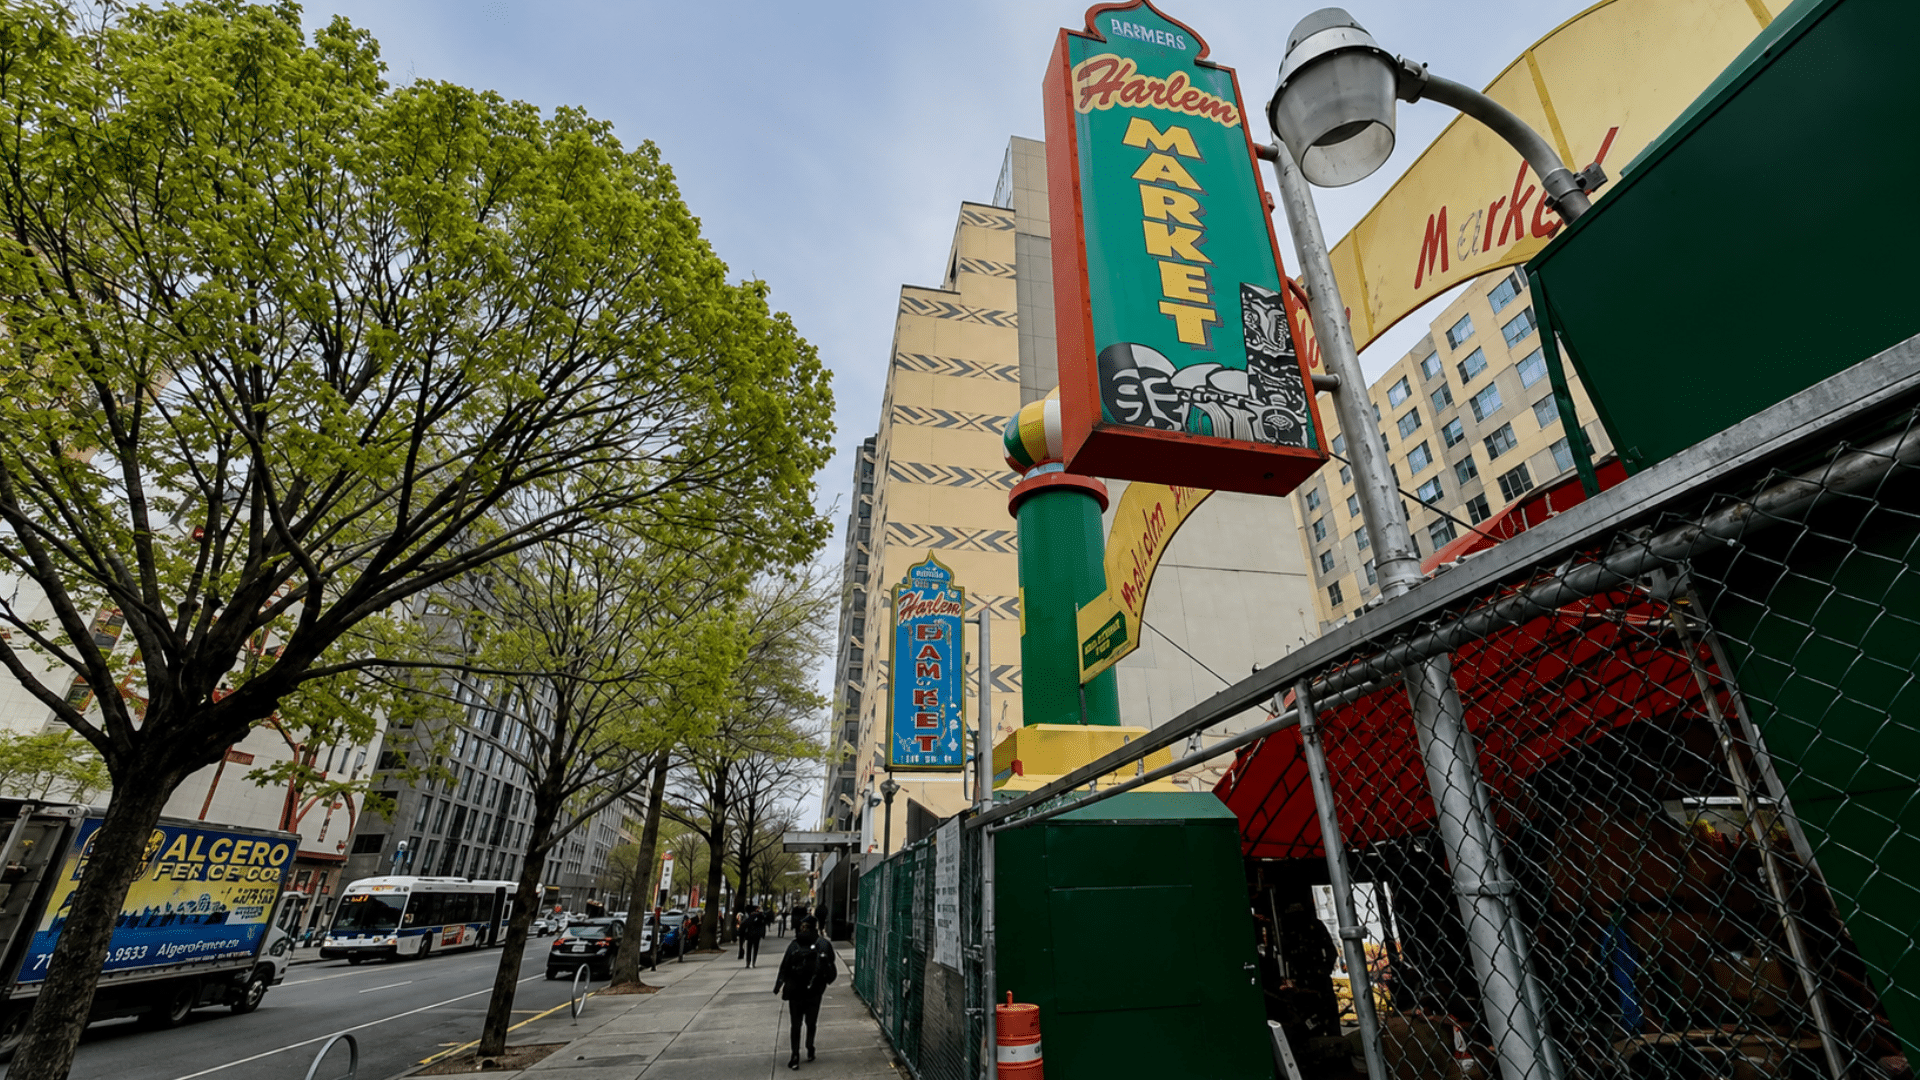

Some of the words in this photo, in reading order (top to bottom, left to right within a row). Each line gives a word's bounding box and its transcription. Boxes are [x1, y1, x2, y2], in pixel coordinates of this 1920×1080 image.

[1072, 54, 1241, 127] Harlem
[1122, 116, 1219, 348] MARKET
[897, 590, 961, 626] Harlem
[162, 833, 289, 866] ALGERO
